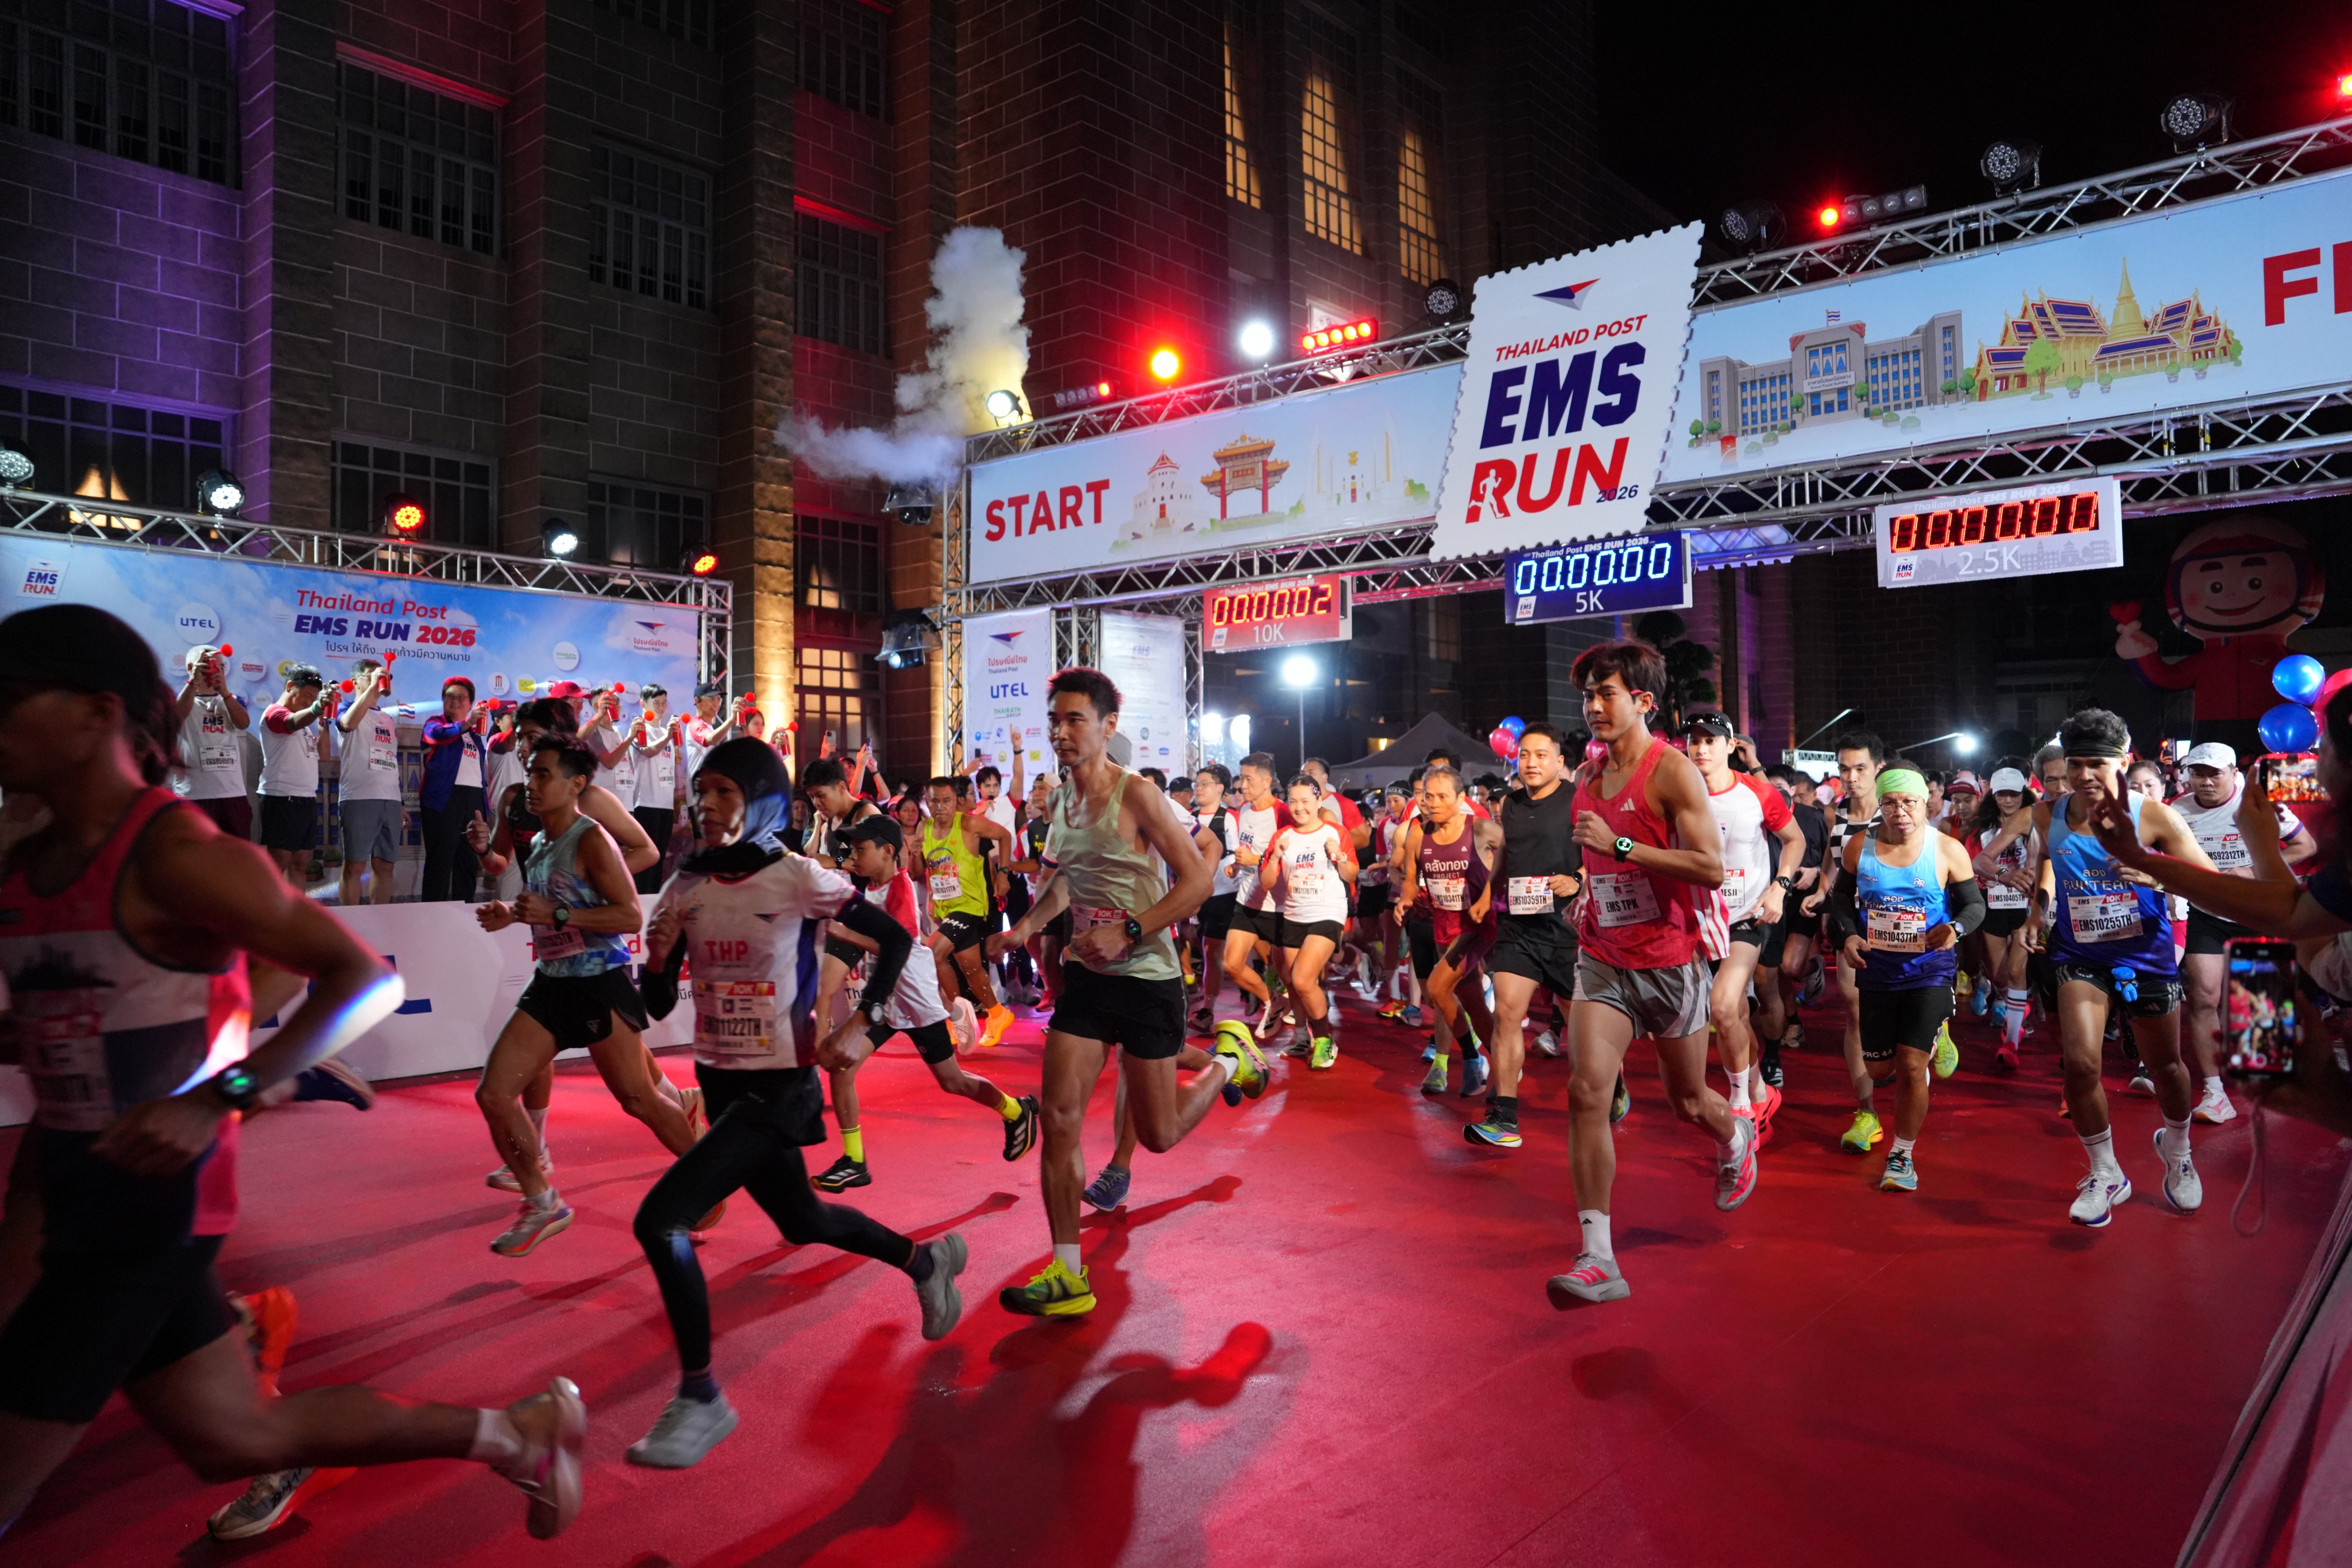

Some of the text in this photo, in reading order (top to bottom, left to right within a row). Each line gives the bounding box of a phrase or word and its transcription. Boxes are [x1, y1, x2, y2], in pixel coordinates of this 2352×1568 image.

[1496, 314, 1648, 362] THAILAND POST
[1480, 341, 1646, 449] EMS
[1465, 436, 1630, 524] RUN
[1596, 485, 1639, 502] 2026
[1913, 483, 2071, 512] Thailand Post EMS RUN 2026
[985, 478, 1110, 541] START
[1531, 536, 1649, 559] Thailand Post EMS RUN 2026
[1959, 545, 2021, 575] 2.5K
[26, 571, 58, 585] EMS
[23, 583, 55, 594] RUN
[1225, 586, 1250, 595] Thailand
[297, 590, 448, 619] Thailand Post
[1575, 589, 1604, 613] 5K
[180, 618, 215, 628] UTEL
[294, 614, 476, 647] EMS RUN 2026
[1253, 623, 1284, 643] 10K
[634, 638, 668, 647] ไปรษณีย์ไทย
[988, 655, 1028, 666] ไปรษณีย์ไทย
[991, 682, 1028, 699] UTEL
[375, 728, 391, 736] EMS
[1240, 832, 1254, 844] EMS
[1296, 853, 1316, 863] EMS
[2000, 847, 2022, 858] EMS
[2205, 850, 2245, 860] MS92312TH
[1425, 859, 1469, 872] คลังทอง
[1617, 874, 1631, 882] 10K
[1293, 886, 1318, 894] EMS11707TH
[1513, 895, 1547, 905] EMS10359TH
[1606, 898, 1639, 912] EMS TPK
[2080, 914, 2133, 931] EMS10255TH
[1874, 929, 1918, 943] EMS10437TH
[704, 940, 749, 962] THP
